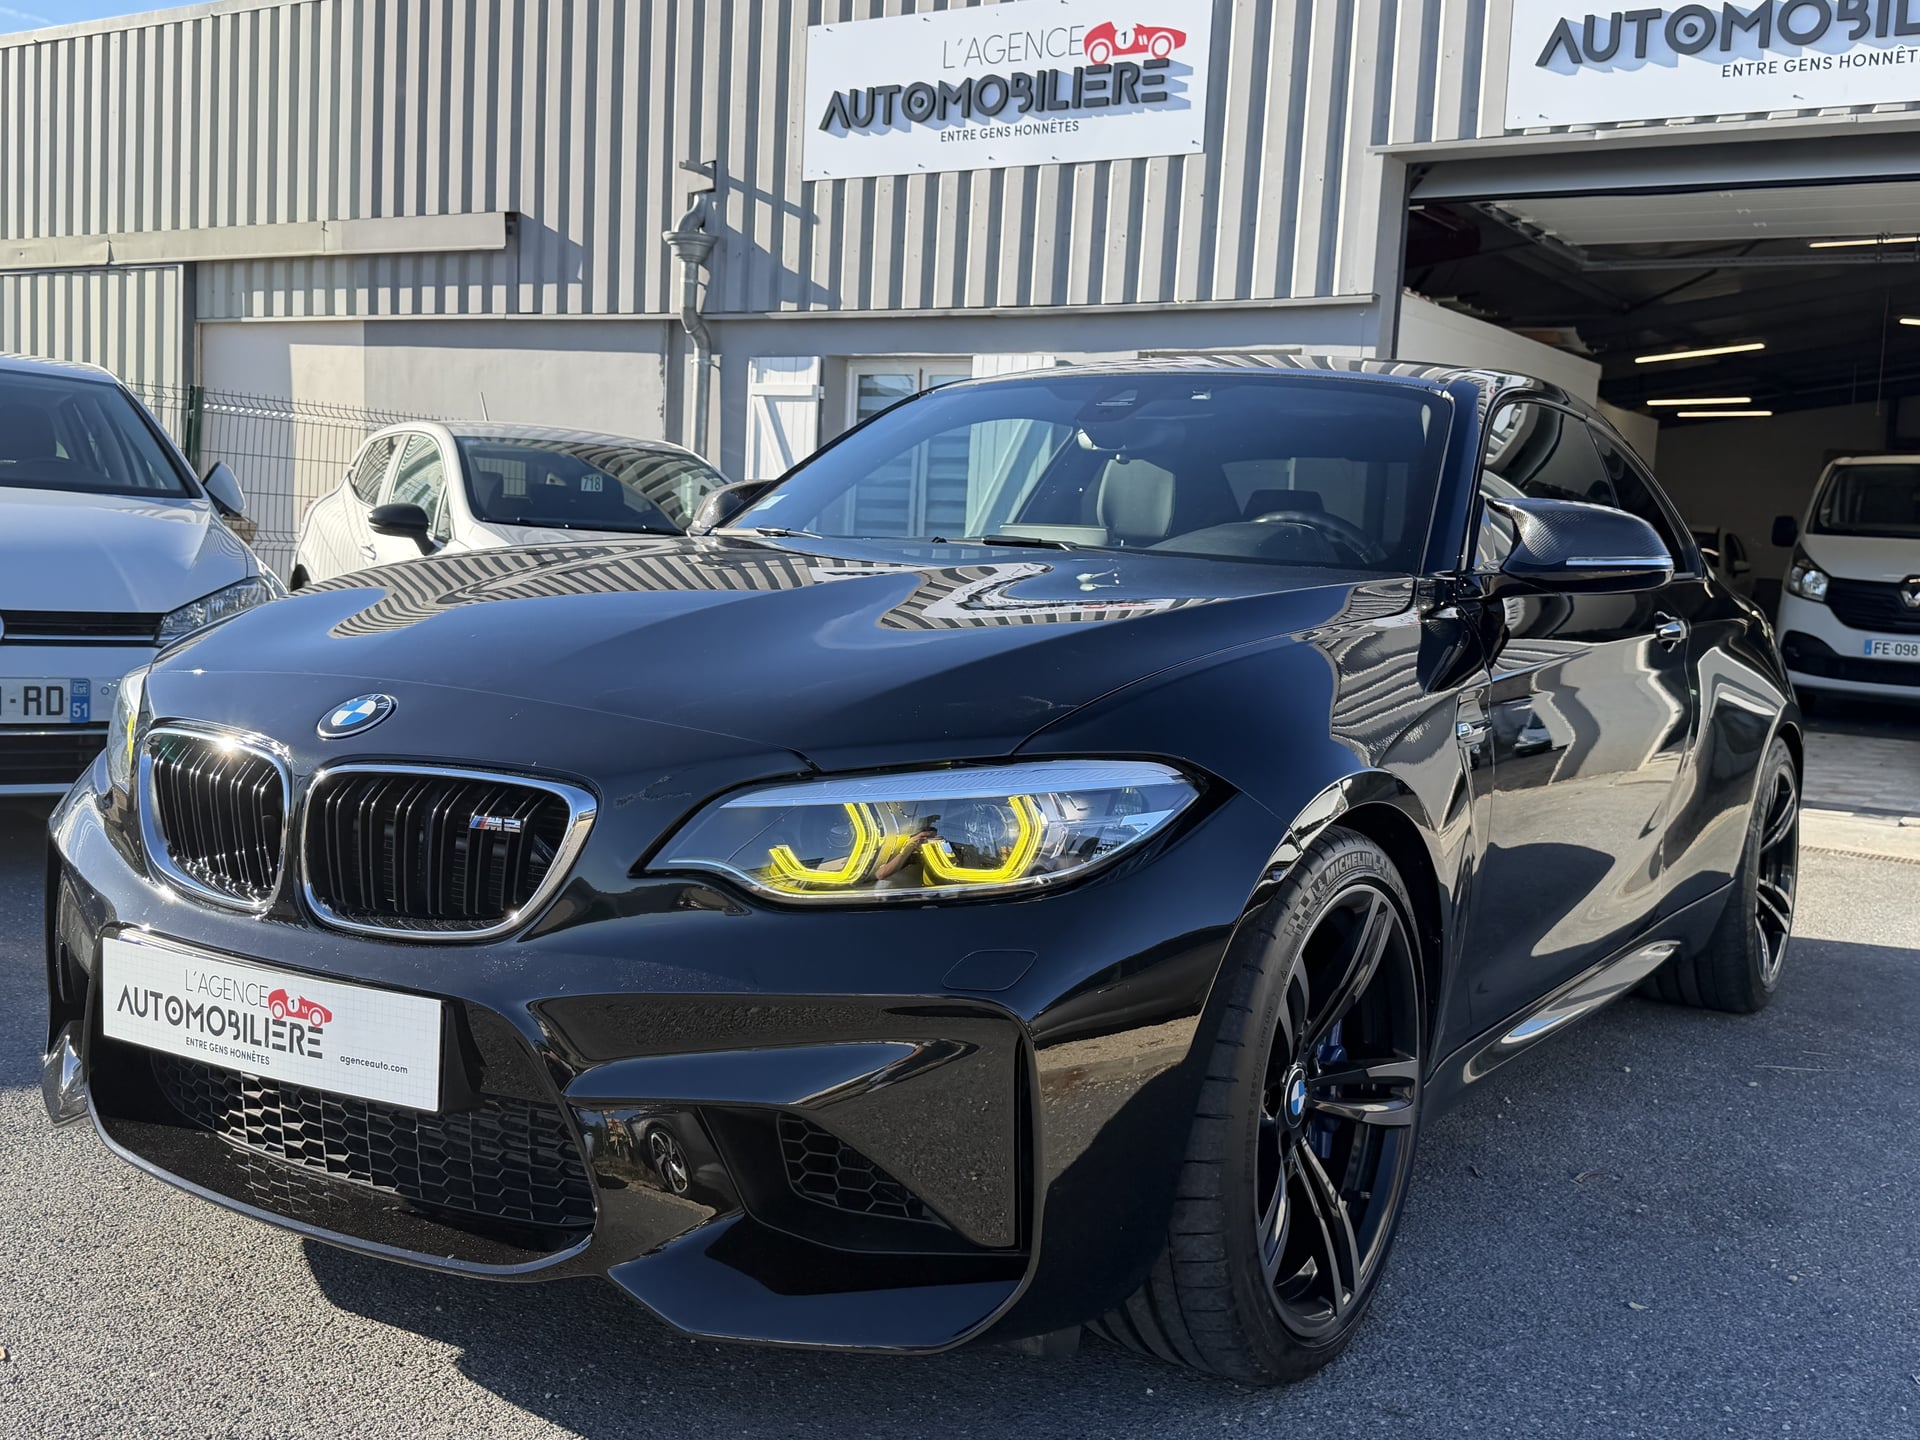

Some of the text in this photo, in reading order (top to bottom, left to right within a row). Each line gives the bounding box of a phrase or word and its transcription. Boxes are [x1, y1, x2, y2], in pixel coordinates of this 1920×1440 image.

[943, 25, 1085, 69] L'AGENCE
[1121, 31, 1128, 44] 1
[1722, 45, 1920, 78] ENTRE GENS HONNÊT
[940, 119, 1080, 142] ENTRE GENS HONNÊTES
[583, 476, 601, 490] 718
[0, 686, 64, 716] -RD
[72, 703, 88, 718] 51
[1325, 851, 1374, 885] MICHELIN
[185, 968, 269, 1009] L'AGENCE
[185, 1036, 208, 1050] ENTRE
[209, 1042, 229, 1055] GENS
[340, 1054, 408, 1075] agenceauto.com
